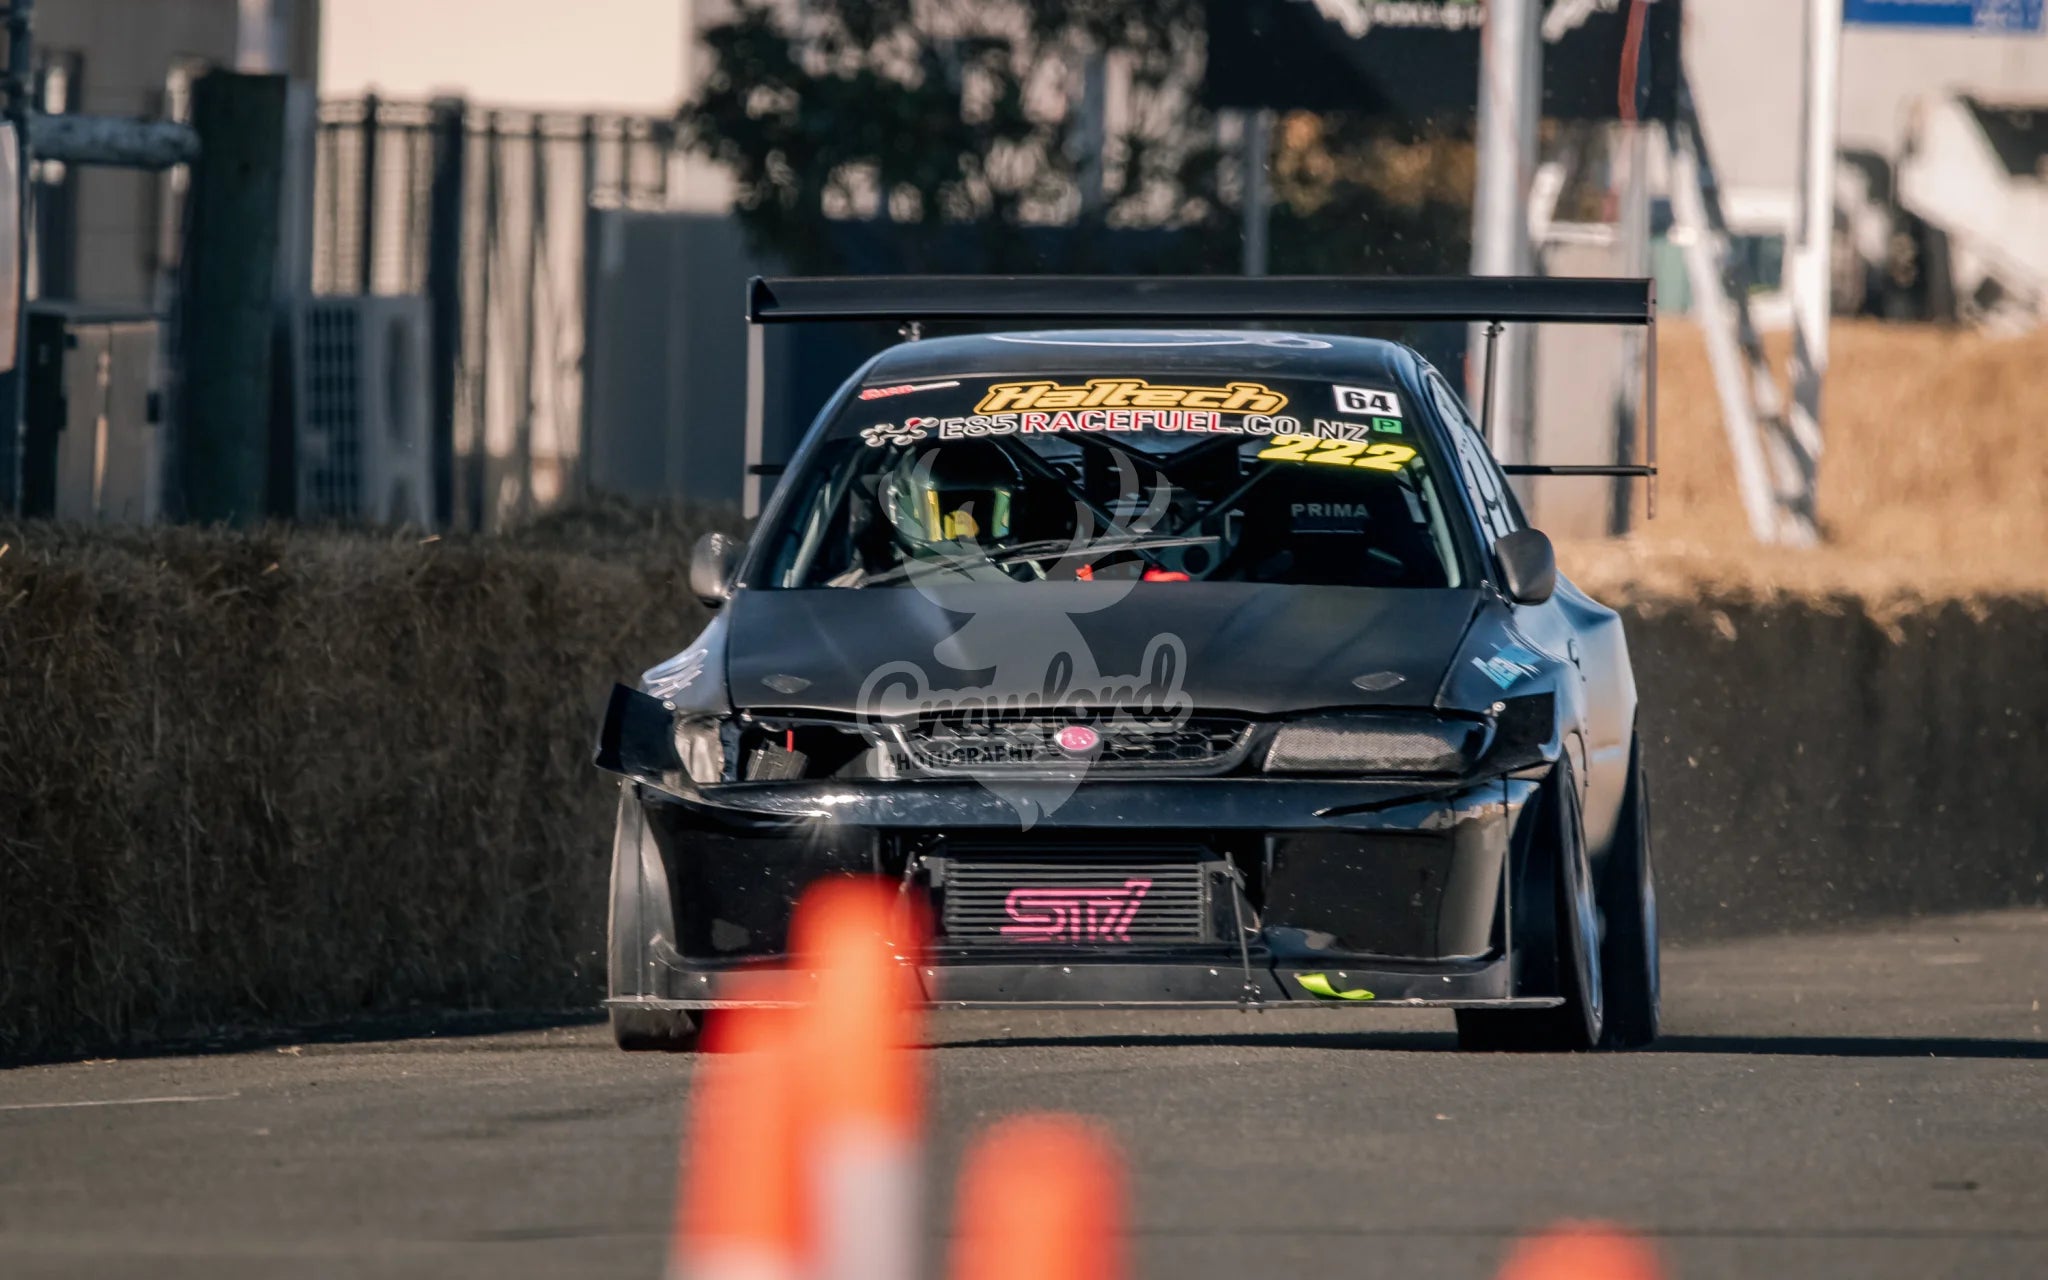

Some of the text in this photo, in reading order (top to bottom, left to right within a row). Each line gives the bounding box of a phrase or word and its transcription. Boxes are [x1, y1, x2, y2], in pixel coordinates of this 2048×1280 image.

[977, 379, 1285, 414] Haltech
[1342, 390, 1393, 412] 64
[1258, 434, 1417, 472] 222
[1291, 503, 1369, 518] PRIMA
